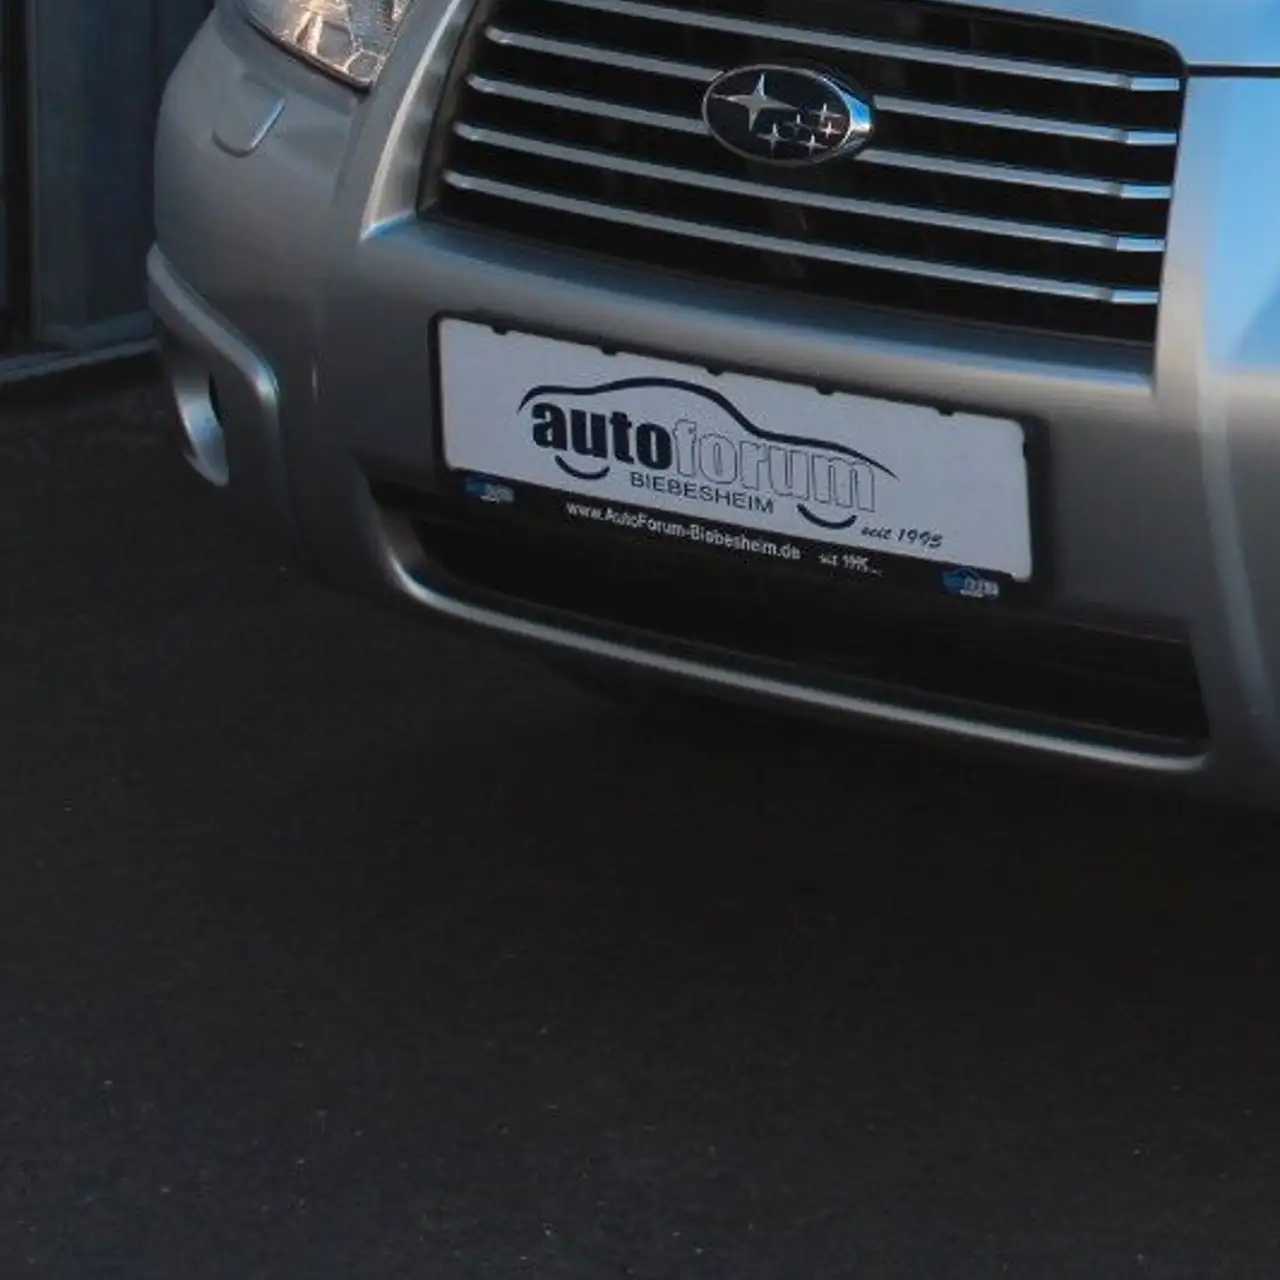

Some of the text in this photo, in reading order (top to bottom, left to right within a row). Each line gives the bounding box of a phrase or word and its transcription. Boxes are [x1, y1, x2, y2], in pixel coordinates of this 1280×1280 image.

[629, 471, 775, 515] BIEBESHEIM
[860, 526, 944, 549] seit 1995
